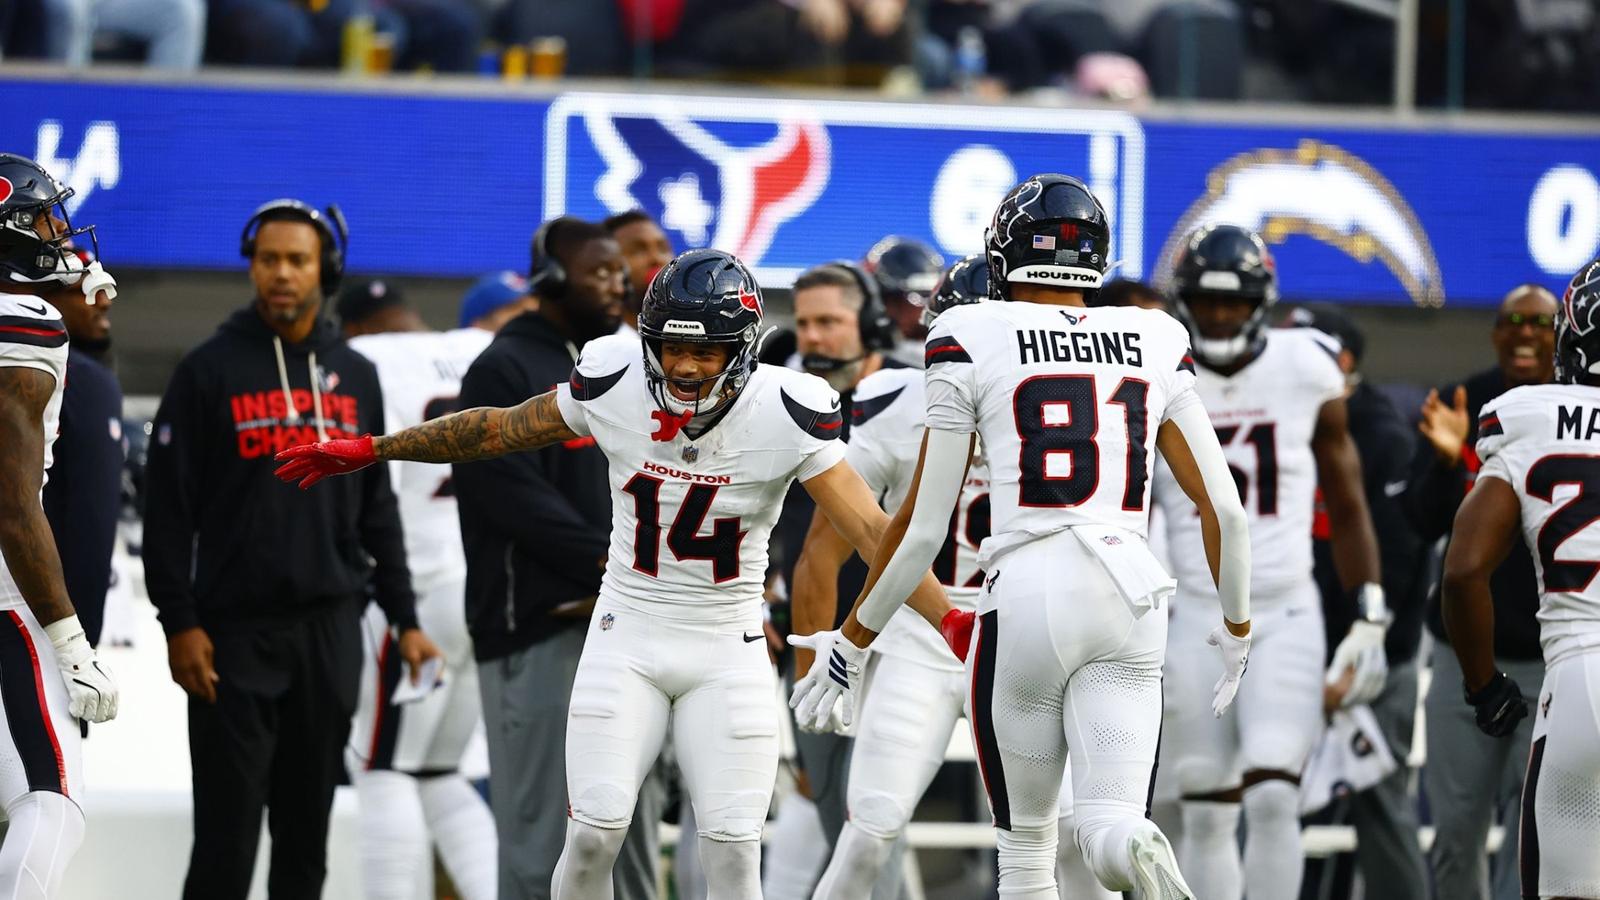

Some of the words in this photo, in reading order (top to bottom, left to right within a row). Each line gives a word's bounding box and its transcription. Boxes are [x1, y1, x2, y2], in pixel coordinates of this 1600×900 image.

[929, 143, 1018, 256] 6
[1526, 163, 1600, 275] 0
[1027, 271, 1098, 283] HOUSTON
[1016, 329, 1142, 368] HIGGINS
[230, 388, 359, 424] INSPRE
[1012, 373, 1150, 511] 81
[1556, 405, 1600, 440] MA
[643, 461, 731, 484] HOUSTON
[622, 471, 749, 584] 14
[1525, 453, 1600, 593] 2
